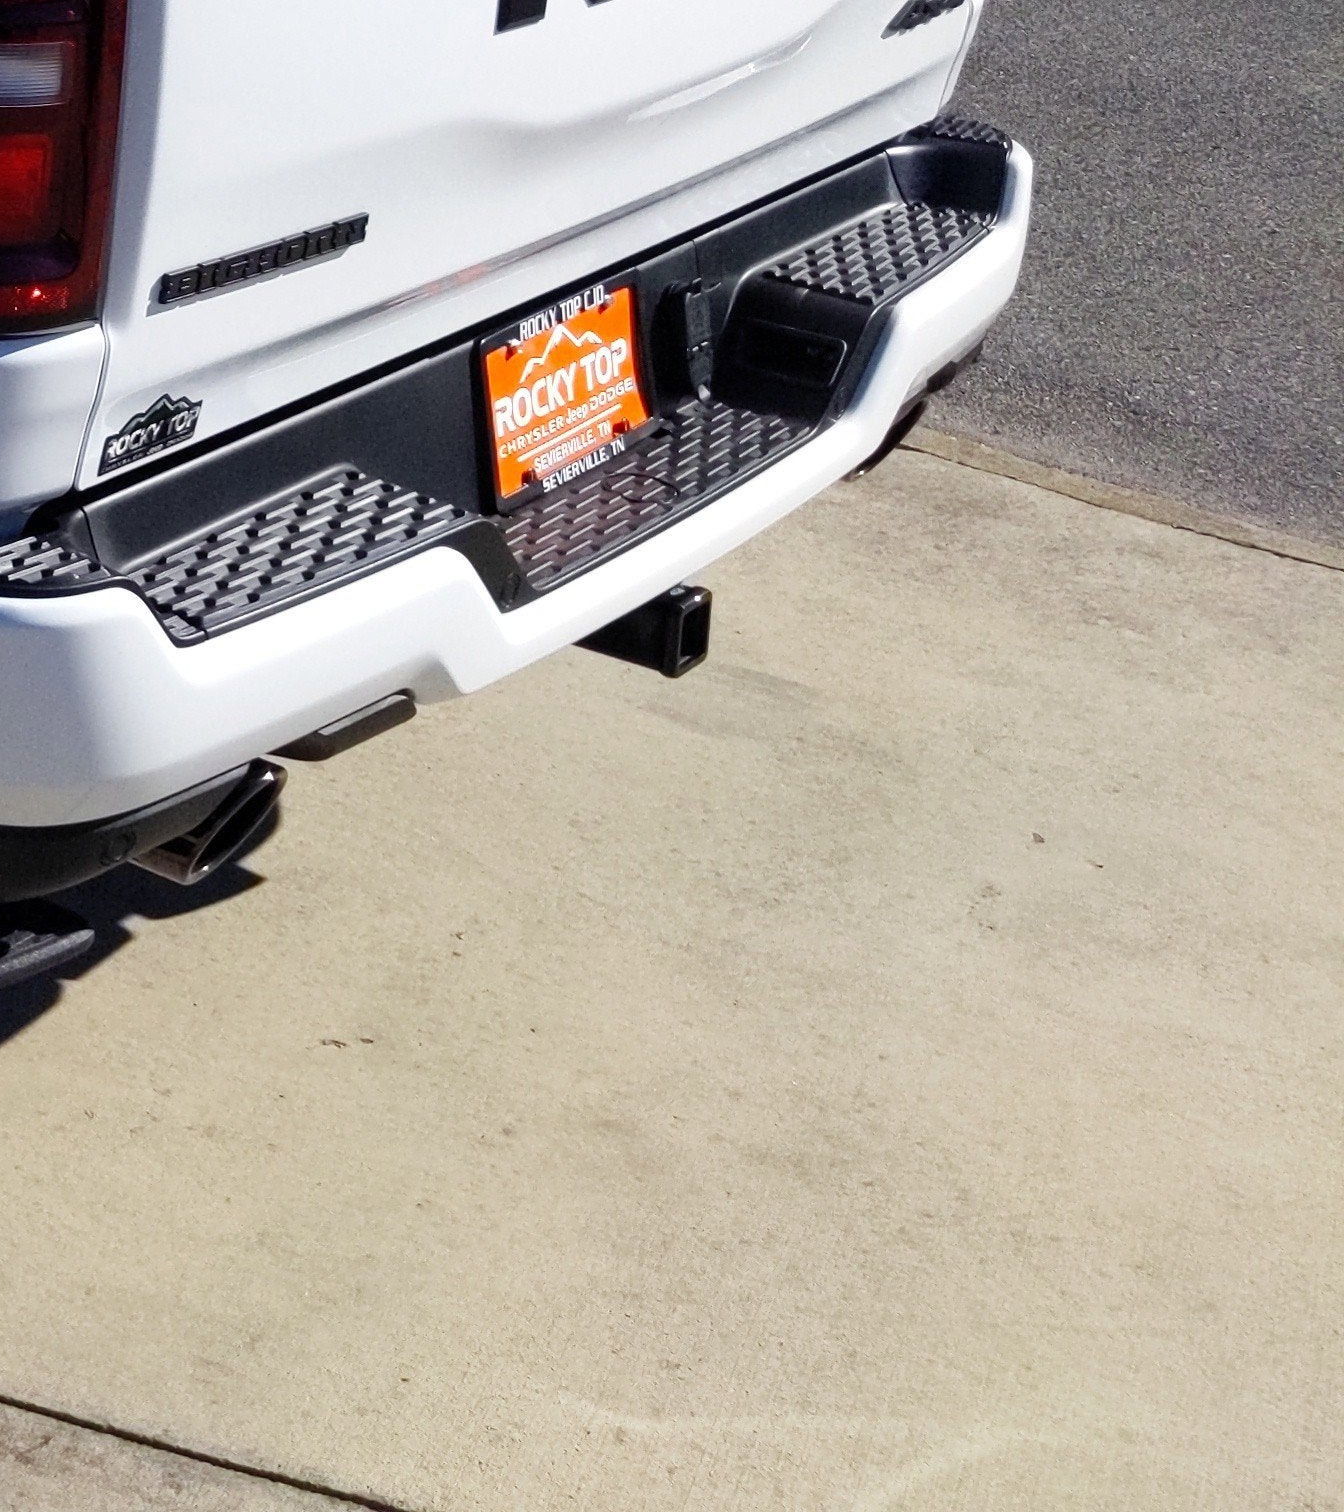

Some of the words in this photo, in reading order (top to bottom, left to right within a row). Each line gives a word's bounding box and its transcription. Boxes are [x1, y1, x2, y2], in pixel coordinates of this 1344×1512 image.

[519, 306, 557, 342] ROCKY
[559, 295, 581, 322] TOP
[494, 362, 577, 438] ROCKY
[579, 338, 627, 392] TOP
[499, 415, 565, 458] CHRYSLER
[565, 403, 589, 424] Jeep
[589, 377, 634, 411] DODGE
[597, 420, 611, 438] TN
[542, 447, 610, 493] SEVIERVILLE,
[610, 434, 626, 456] TN
